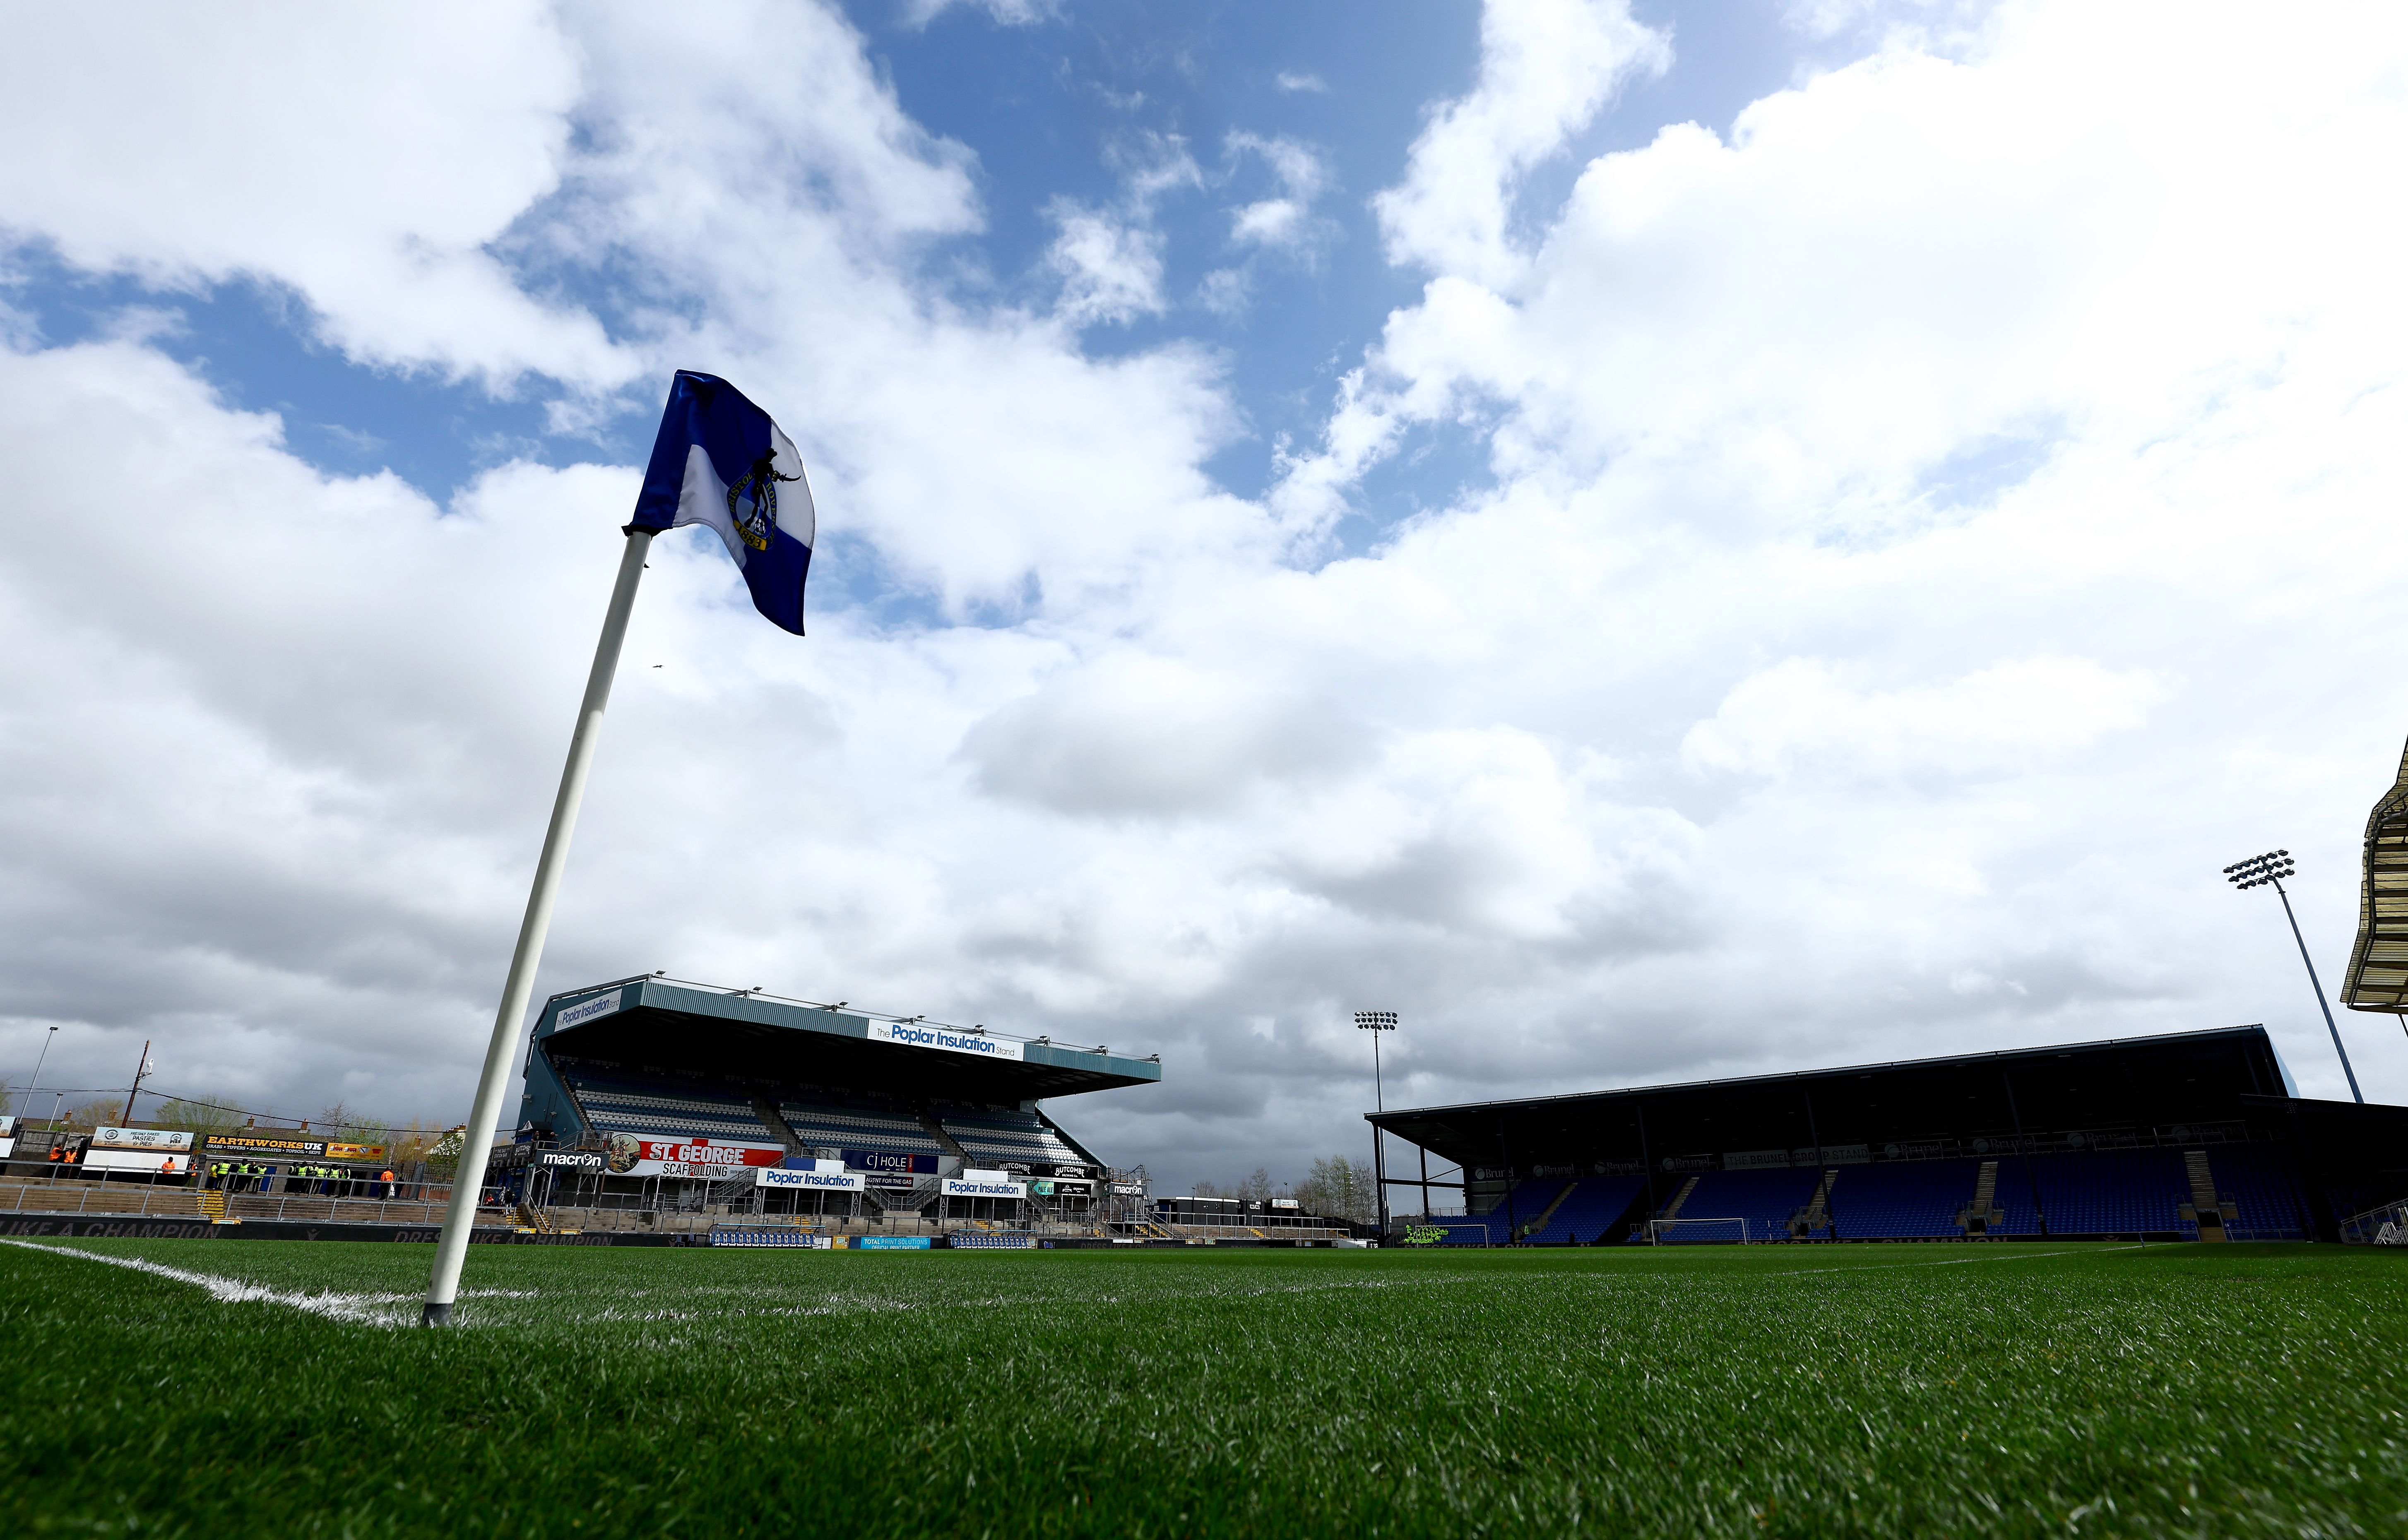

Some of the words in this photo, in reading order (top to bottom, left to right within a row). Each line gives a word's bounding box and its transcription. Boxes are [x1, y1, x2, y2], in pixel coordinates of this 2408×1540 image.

[728, 472, 753, 513] BRISTOL
[737, 524, 762, 548] 1883
[562, 1008, 582, 1025] Poplar
[580, 999, 609, 1018] Insulation
[609, 998, 620, 1009] Stand
[877, 1028, 890, 1038] The
[891, 1024, 935, 1044] Poplar
[937, 1031, 995, 1053] Insulation
[996, 1046, 1015, 1057] Stand
[514, 1145, 531, 1156] BUTCOMBE
[649, 1143, 674, 1160] ST.
[678, 1145, 746, 1165] GEORGE
[1899, 1141, 1943, 1156] Brunel
[543, 1153, 601, 1167] macron
[880, 1156, 907, 1167] HOLE
[1676, 1156, 1711, 1168] Brunel
[1728, 1156, 1748, 1165] THE
[1750, 1153, 1790, 1164] BRUNEL
[1794, 1151, 1829, 1162] GROP
[1833, 1148, 1868, 1160] STAND
[663, 1163, 728, 1177] SCAFFOLDING
[999, 1163, 1030, 1175] BUTCOMBE
[1054, 1166, 1085, 1177] BUTCOMBE
[1544, 1163, 1575, 1175] Brunel
[1607, 1160, 1639, 1171] Brunel
[766, 1170, 803, 1185] Poplar
[804, 1173, 854, 1187] Insulation
[949, 1181, 978, 1194] Poplar
[979, 1183, 1019, 1194] Insulation
[1114, 1185, 1142, 1194] macron
[57, 1222, 75, 1237] A
[83, 1223, 222, 1239] CHAMPION
[505, 1235, 516, 1244] A
[522, 1234, 613, 1246] CHAMPION
